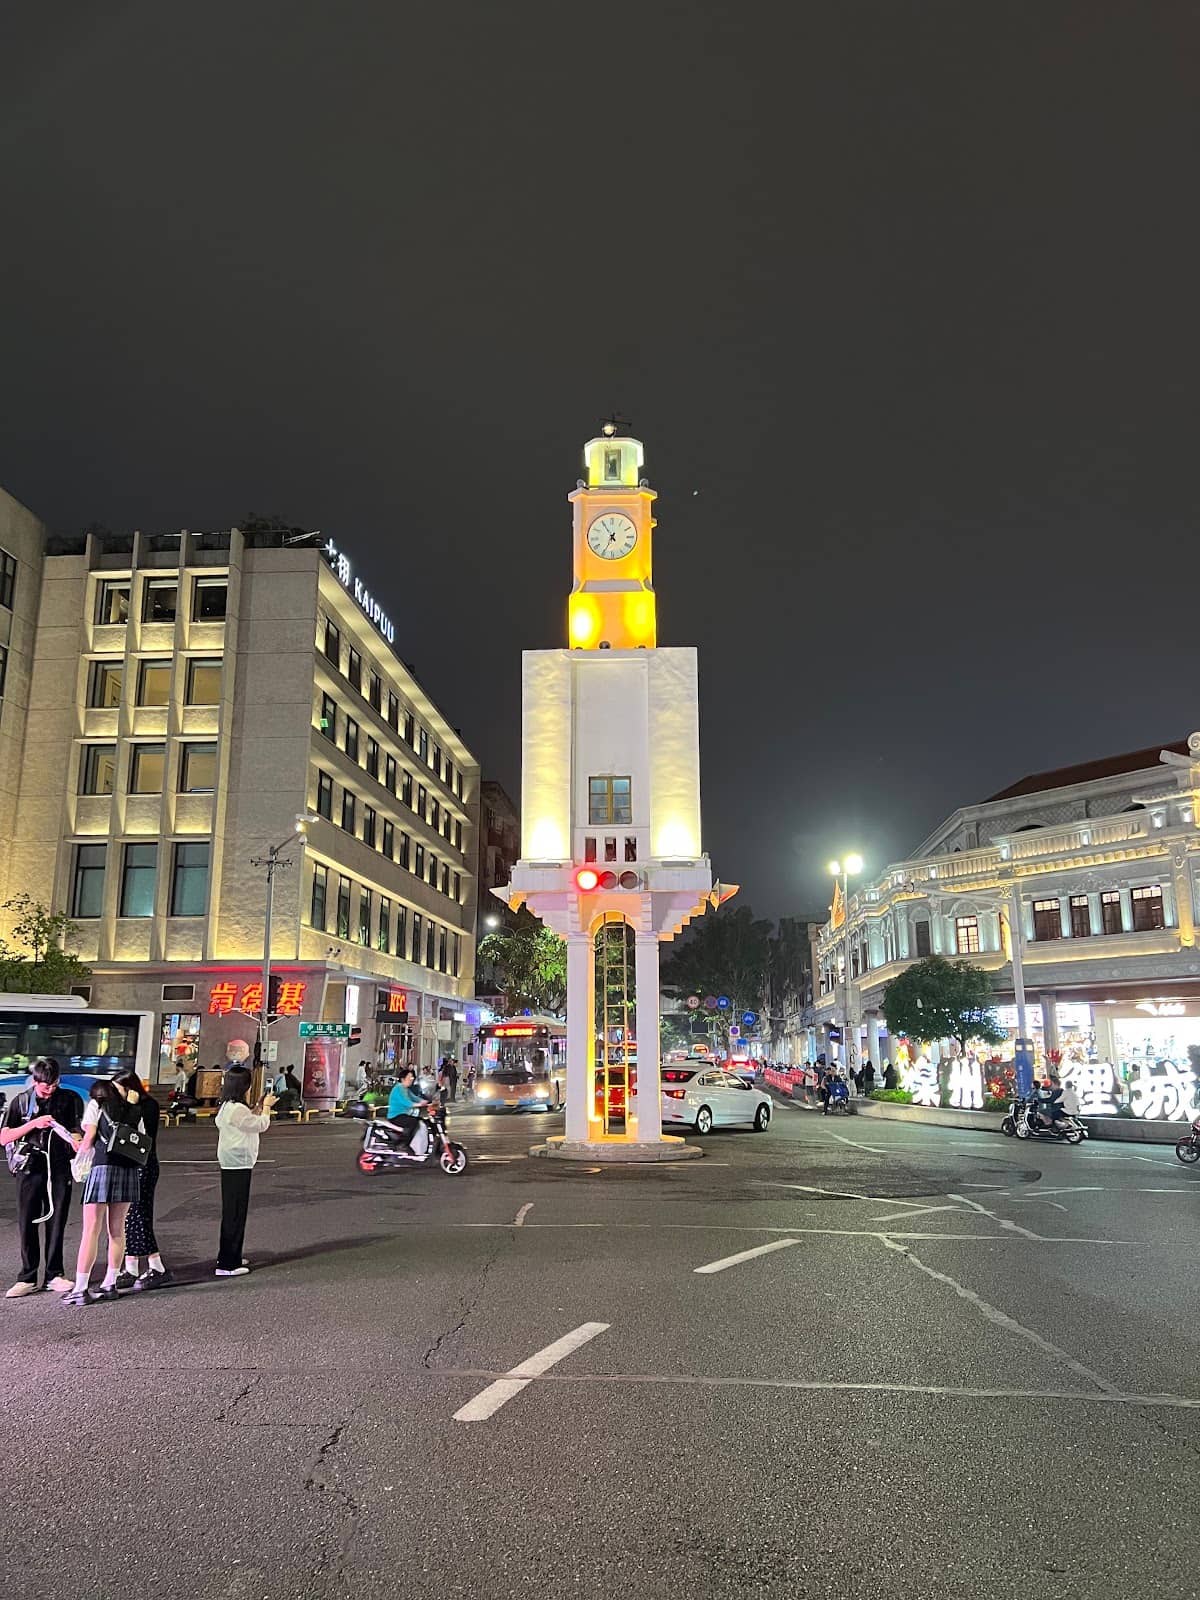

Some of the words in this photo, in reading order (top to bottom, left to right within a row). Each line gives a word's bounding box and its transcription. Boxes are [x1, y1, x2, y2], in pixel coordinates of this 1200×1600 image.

[354, 577, 394, 643] KAIPUU
[208, 982, 305, 1014] 肯德基
[389, 992, 406, 1012] KFC
